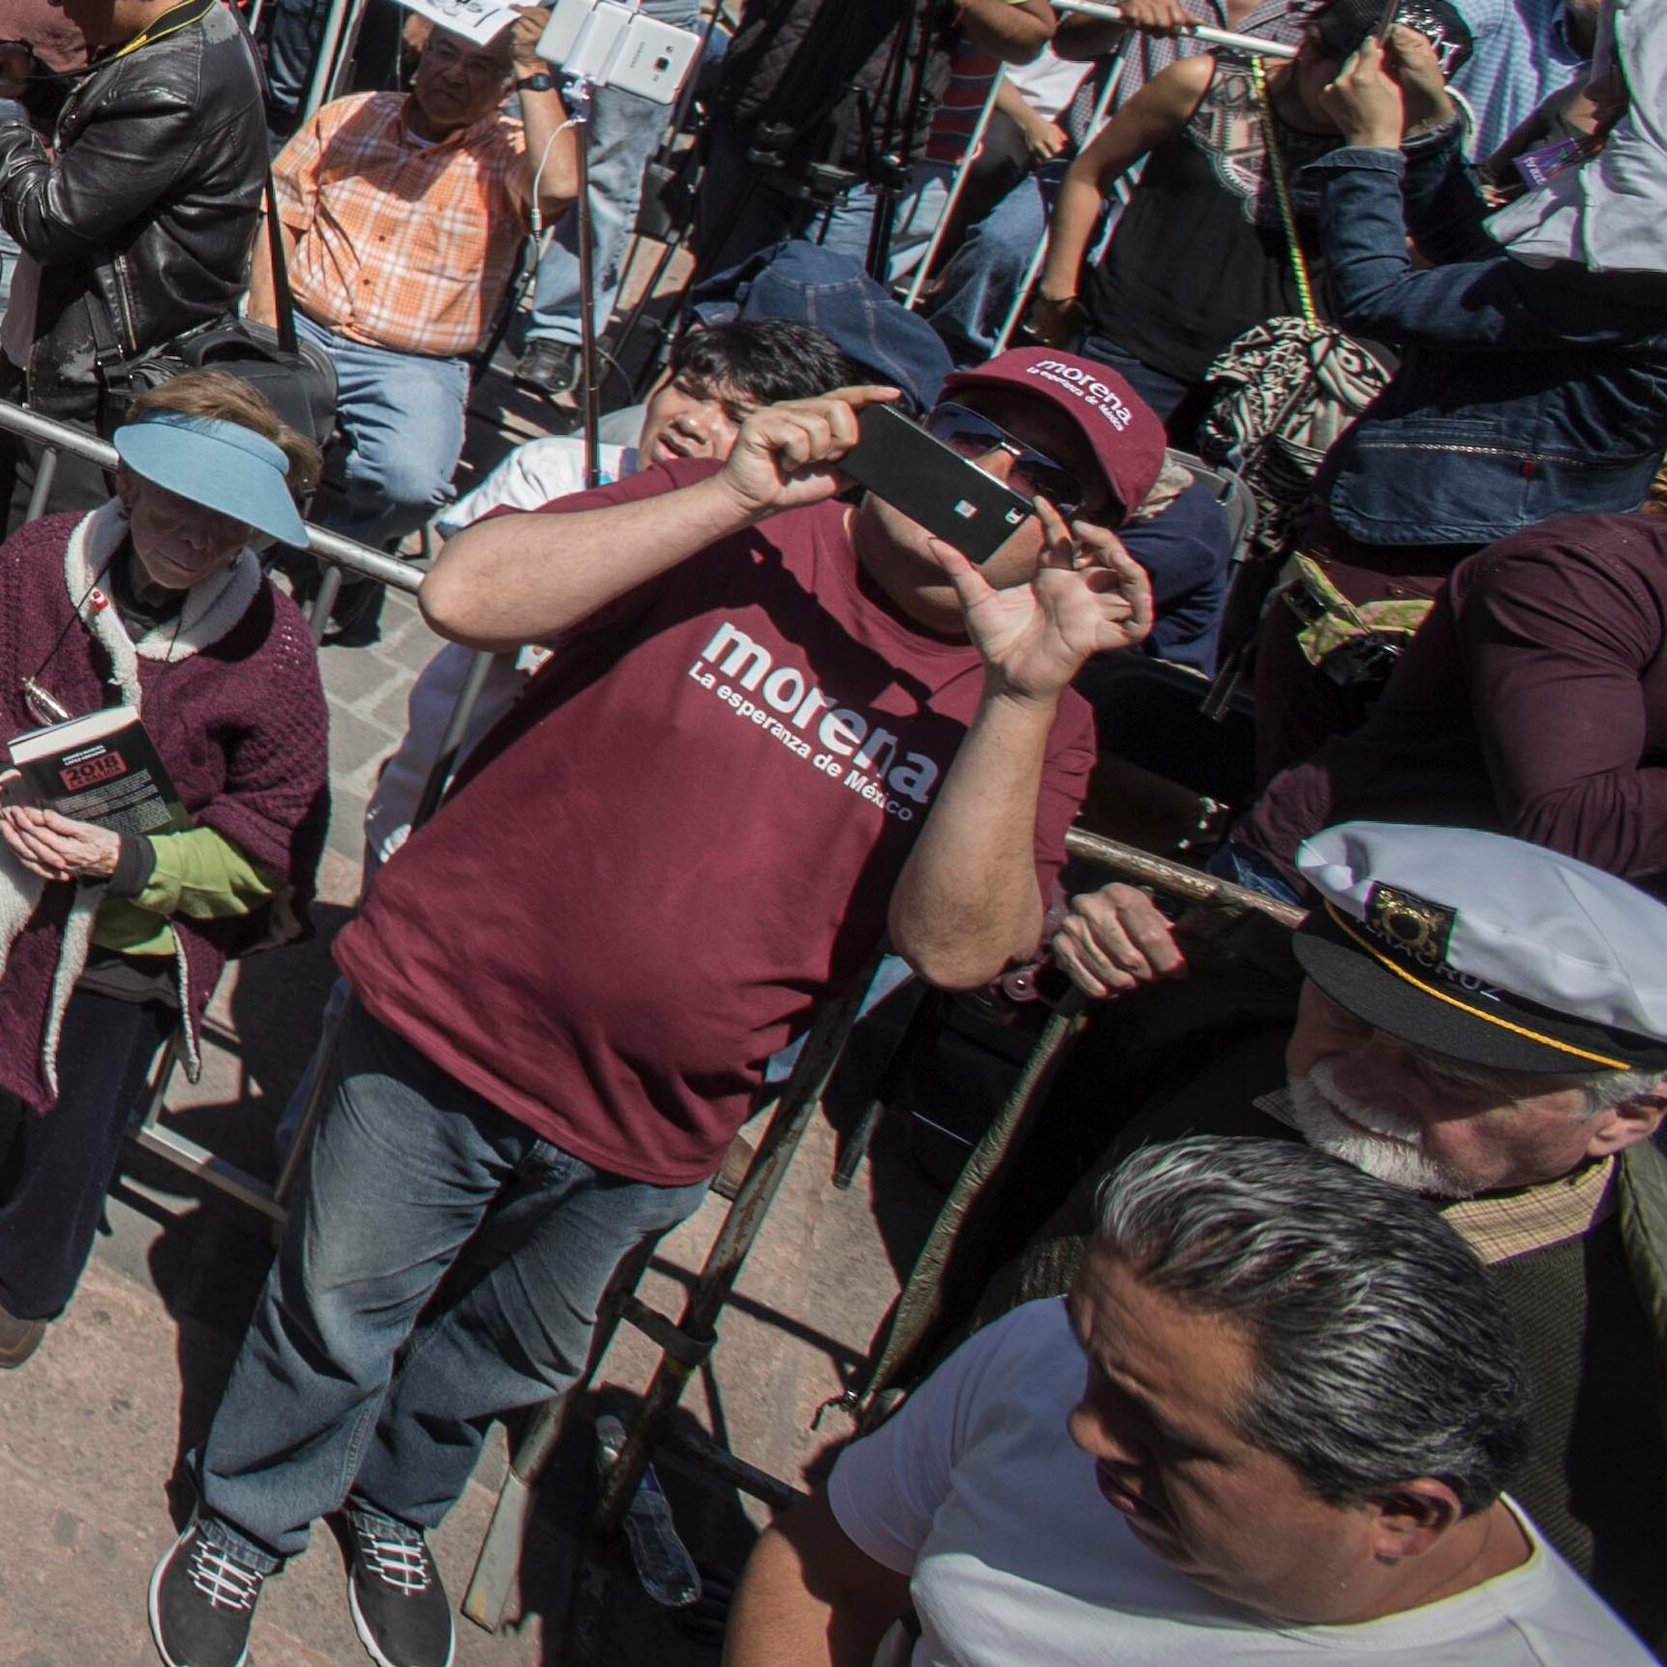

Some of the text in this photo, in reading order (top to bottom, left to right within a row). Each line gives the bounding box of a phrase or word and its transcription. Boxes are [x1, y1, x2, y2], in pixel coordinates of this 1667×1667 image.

[1036, 359, 1132, 426] morena
[688, 661, 914, 821] La esperanza de México
[700, 621, 940, 804] morena
[66, 755, 119, 781] 2018
[1355, 918, 1505, 1002] ACRUZ
